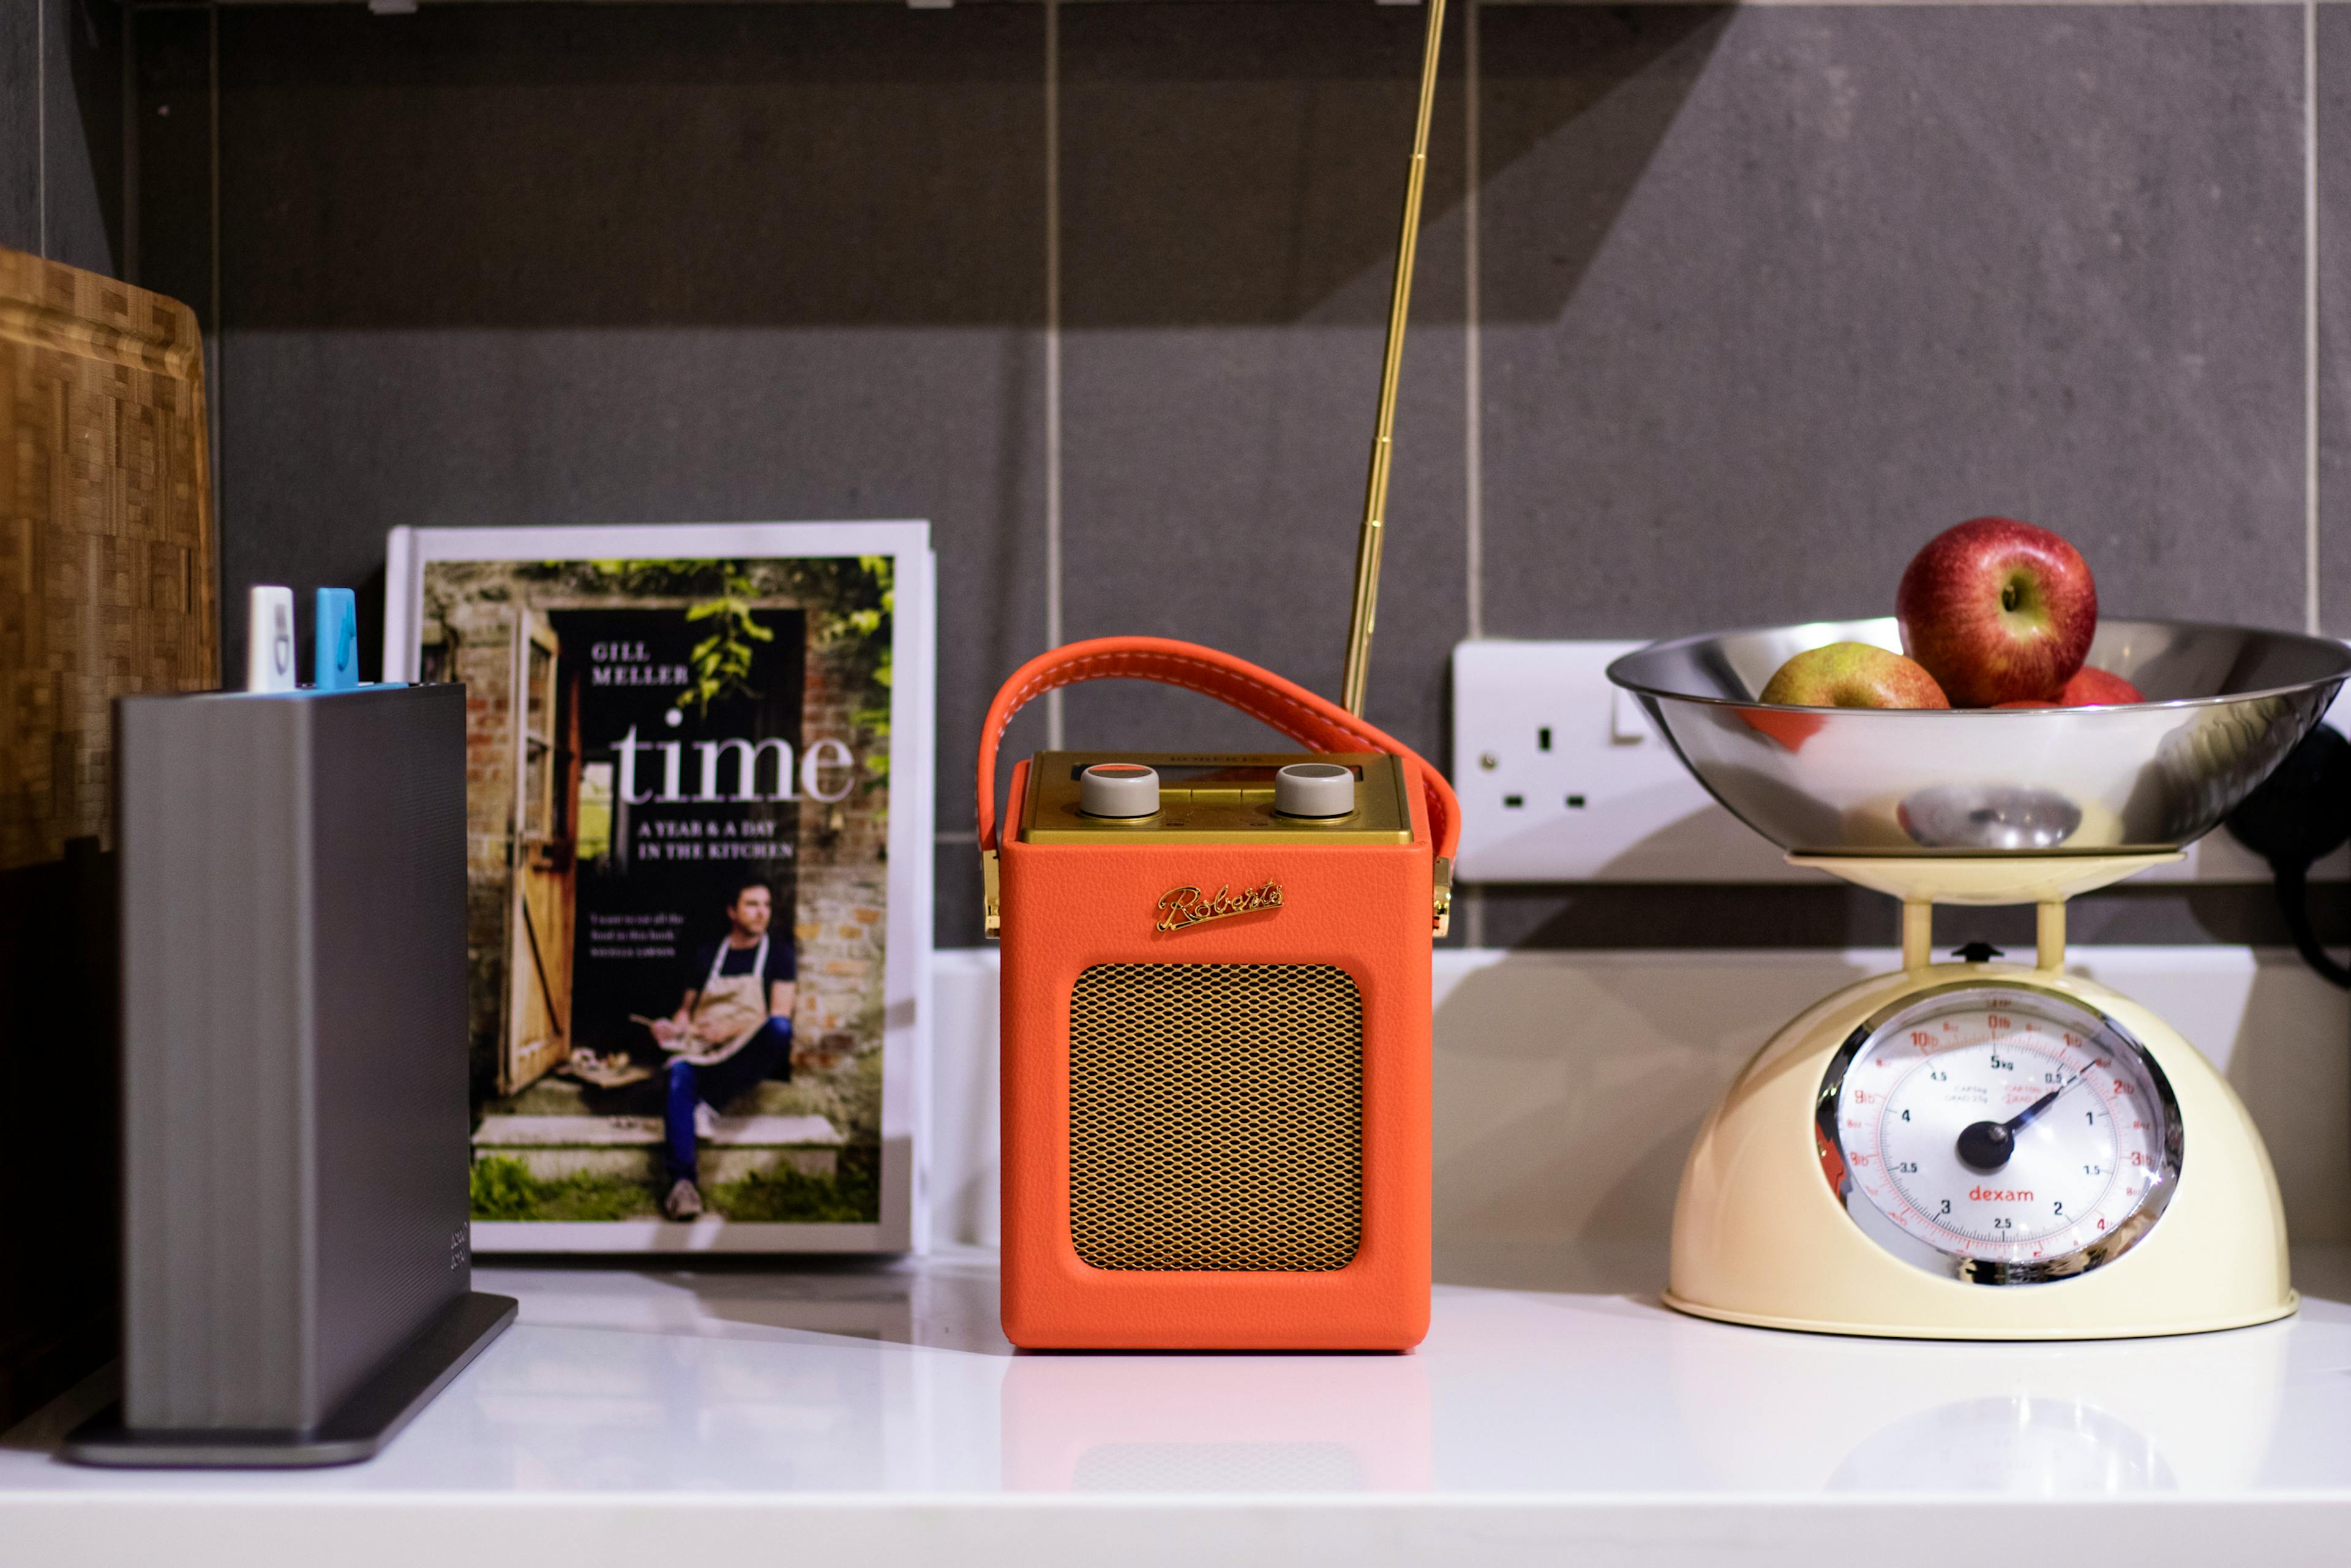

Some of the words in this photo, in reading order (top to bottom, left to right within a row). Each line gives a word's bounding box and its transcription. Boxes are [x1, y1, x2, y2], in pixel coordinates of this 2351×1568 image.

[592, 642, 650, 662] GILL
[592, 666, 689, 685] MELLER
[610, 708, 855, 804] time
[638, 821, 651, 837] A
[655, 820, 703, 837] YEAR
[707, 820, 719, 837] &
[724, 821, 737, 837] A
[741, 820, 776, 837] DAY
[639, 842, 660, 859] IN
[666, 842, 703, 859] THE
[708, 842, 793, 859] KITCHEN
[1157, 879, 1283, 931] Roberts
[1991, 1056, 2014, 1071] 5kg
[1930, 1071, 1947, 1081] 4.5
[2045, 1073, 2062, 1084] 0.5
[2113, 1079, 2134, 1095] 2lb
[1902, 1109, 1910, 1122] 4
[2086, 1112, 2093, 1125] 1
[2131, 1152, 2152, 1166] 3lb
[1900, 1163, 1918, 1173] 3.5
[2083, 1165, 2100, 1175] 1.5
[1969, 1185, 2034, 1201] dexam
[1941, 1199, 1951, 1214] 3
[2054, 1201, 2063, 1215] 2
[1995, 1218, 2011, 1228] 2.5
